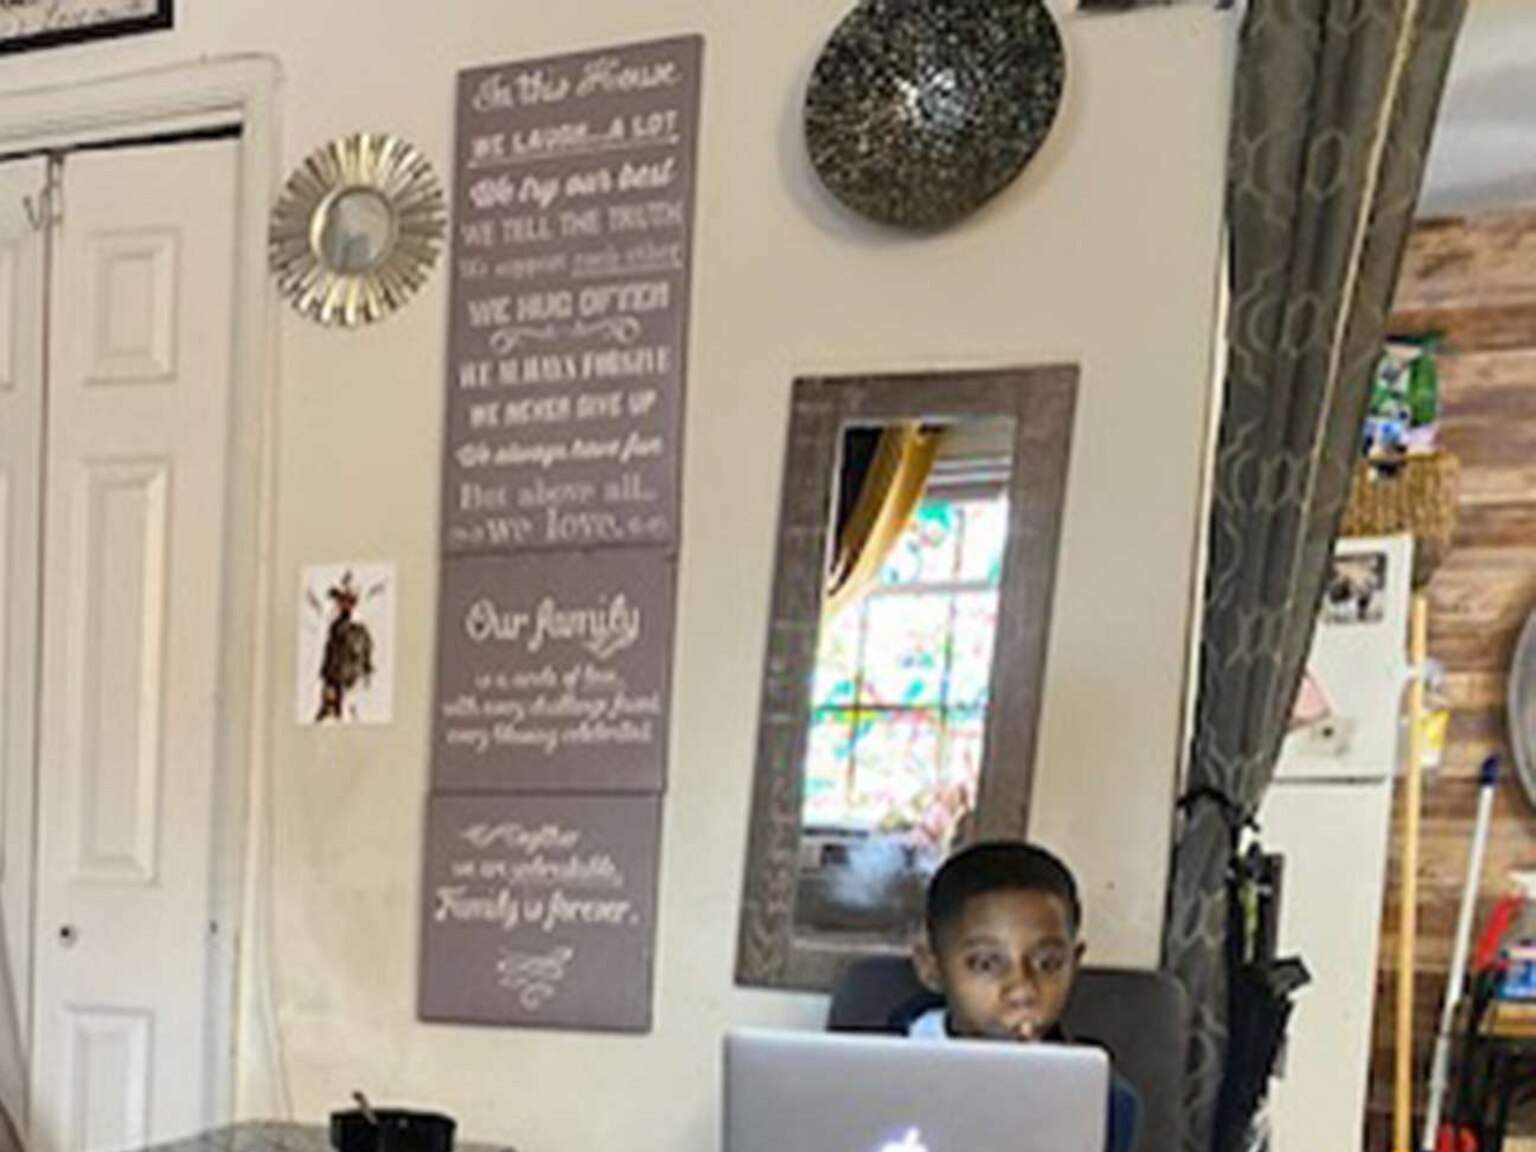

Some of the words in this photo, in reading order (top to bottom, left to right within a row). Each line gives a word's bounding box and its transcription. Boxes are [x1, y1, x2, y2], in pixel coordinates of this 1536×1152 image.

[473, 73, 514, 112] In
[575, 58, 683, 97] House
[472, 132, 505, 158] WE
[630, 110, 677, 137] LOT
[469, 173, 514, 208] We
[517, 175, 560, 208] try
[565, 168, 611, 197] our
[618, 156, 676, 191] best
[460, 220, 494, 247] WE
[502, 215, 552, 244] TELL
[559, 207, 601, 235] THE
[608, 201, 683, 231] TRUTH
[468, 296, 510, 327] WE
[517, 290, 573, 320] HUG
[579, 281, 669, 317] OFTEN
[460, 361, 493, 389] WE
[498, 353, 576, 385] ALWAYS
[582, 346, 670, 379] FORGIVE
[469, 401, 500, 428] WE
[505, 396, 569, 426] NEVER
[575, 392, 622, 420] GIVE
[628, 389, 658, 416] UP
[454, 442, 491, 468] We
[494, 443, 567, 470] always
[570, 438, 620, 460] have
[460, 482, 507, 510] But
[517, 478, 596, 506] above
[486, 516, 533, 543] we
[465, 598, 528, 642] Our
[526, 593, 640, 660] family
[434, 884, 520, 930] Family
[522, 899, 544, 922] is
